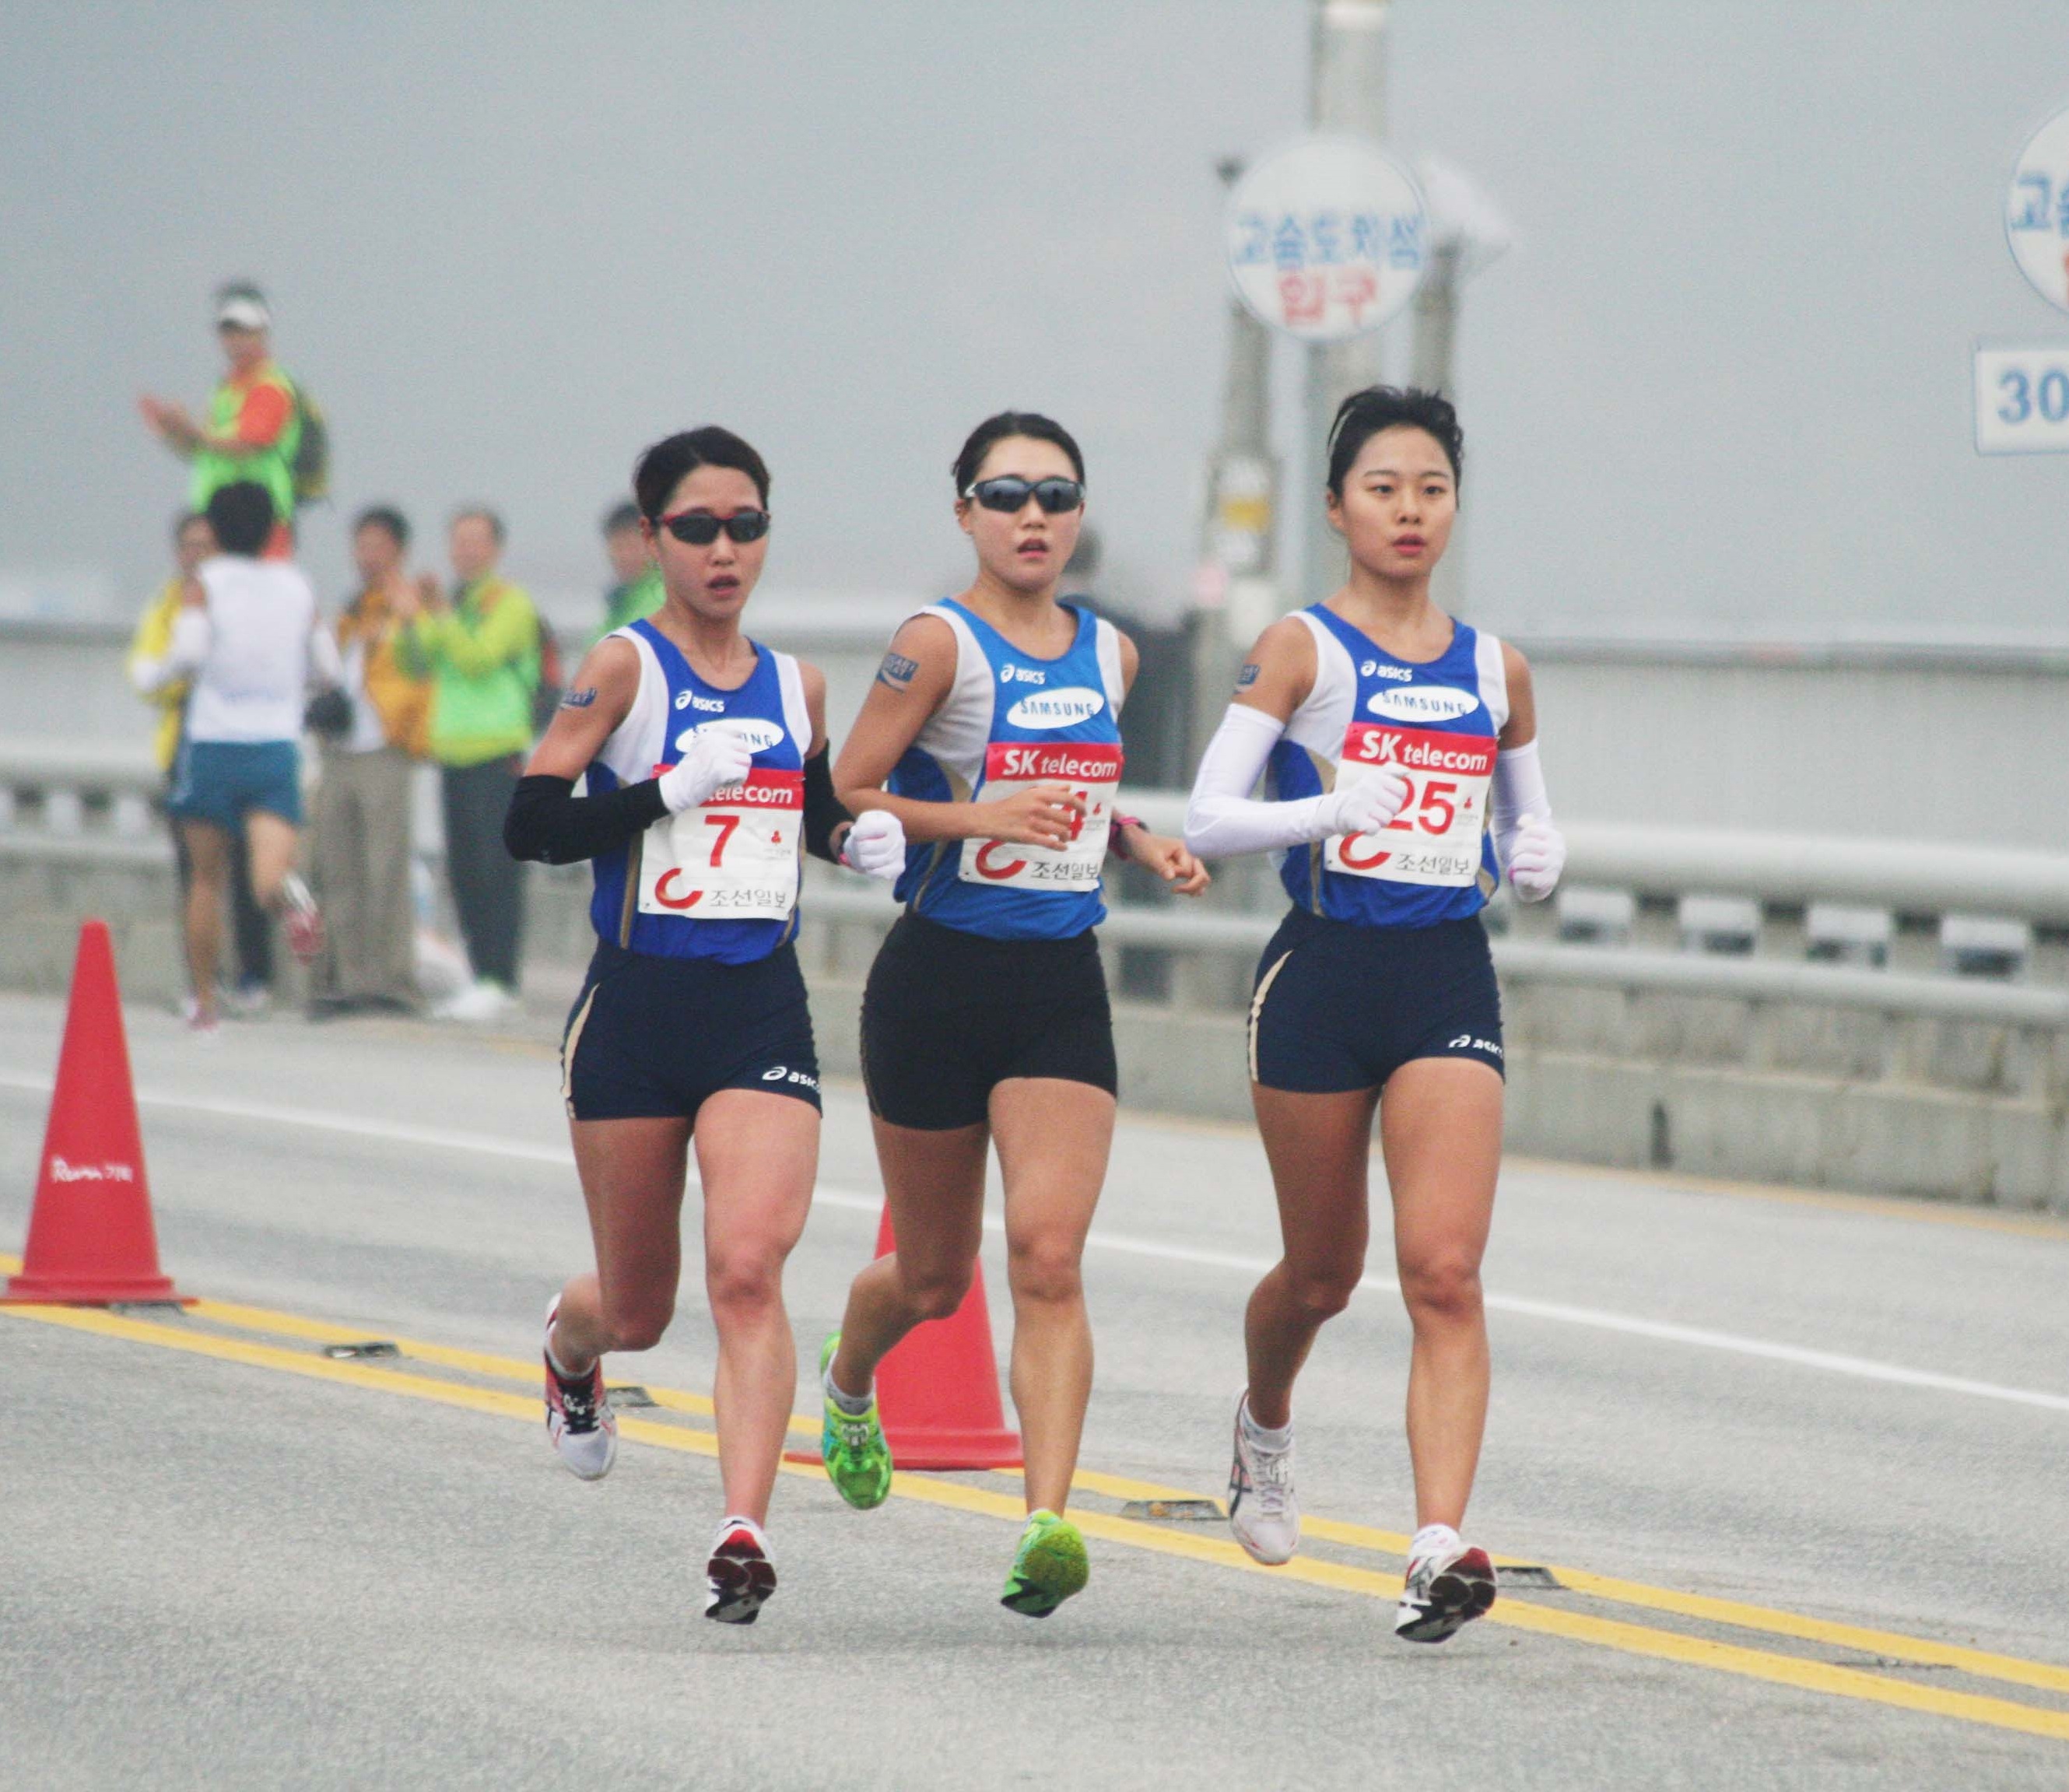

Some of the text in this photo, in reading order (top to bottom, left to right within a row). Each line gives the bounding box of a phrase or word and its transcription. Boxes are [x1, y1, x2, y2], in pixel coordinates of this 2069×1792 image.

[1278, 272, 1377, 323] 입구
[1020, 700, 1094, 716] SAMSUNG
[1382, 691, 1467, 715] SAMSUNG
[1003, 749, 1117, 778] SK telecom
[1359, 730, 1488, 771] SK telecom
[1387, 776, 1457, 835] 25
[705, 815, 740, 867] 7
[1030, 860, 1099, 881] 조선일보
[1397, 854, 1472, 875] 조선일보
[710, 889, 787, 908] 조선일보
